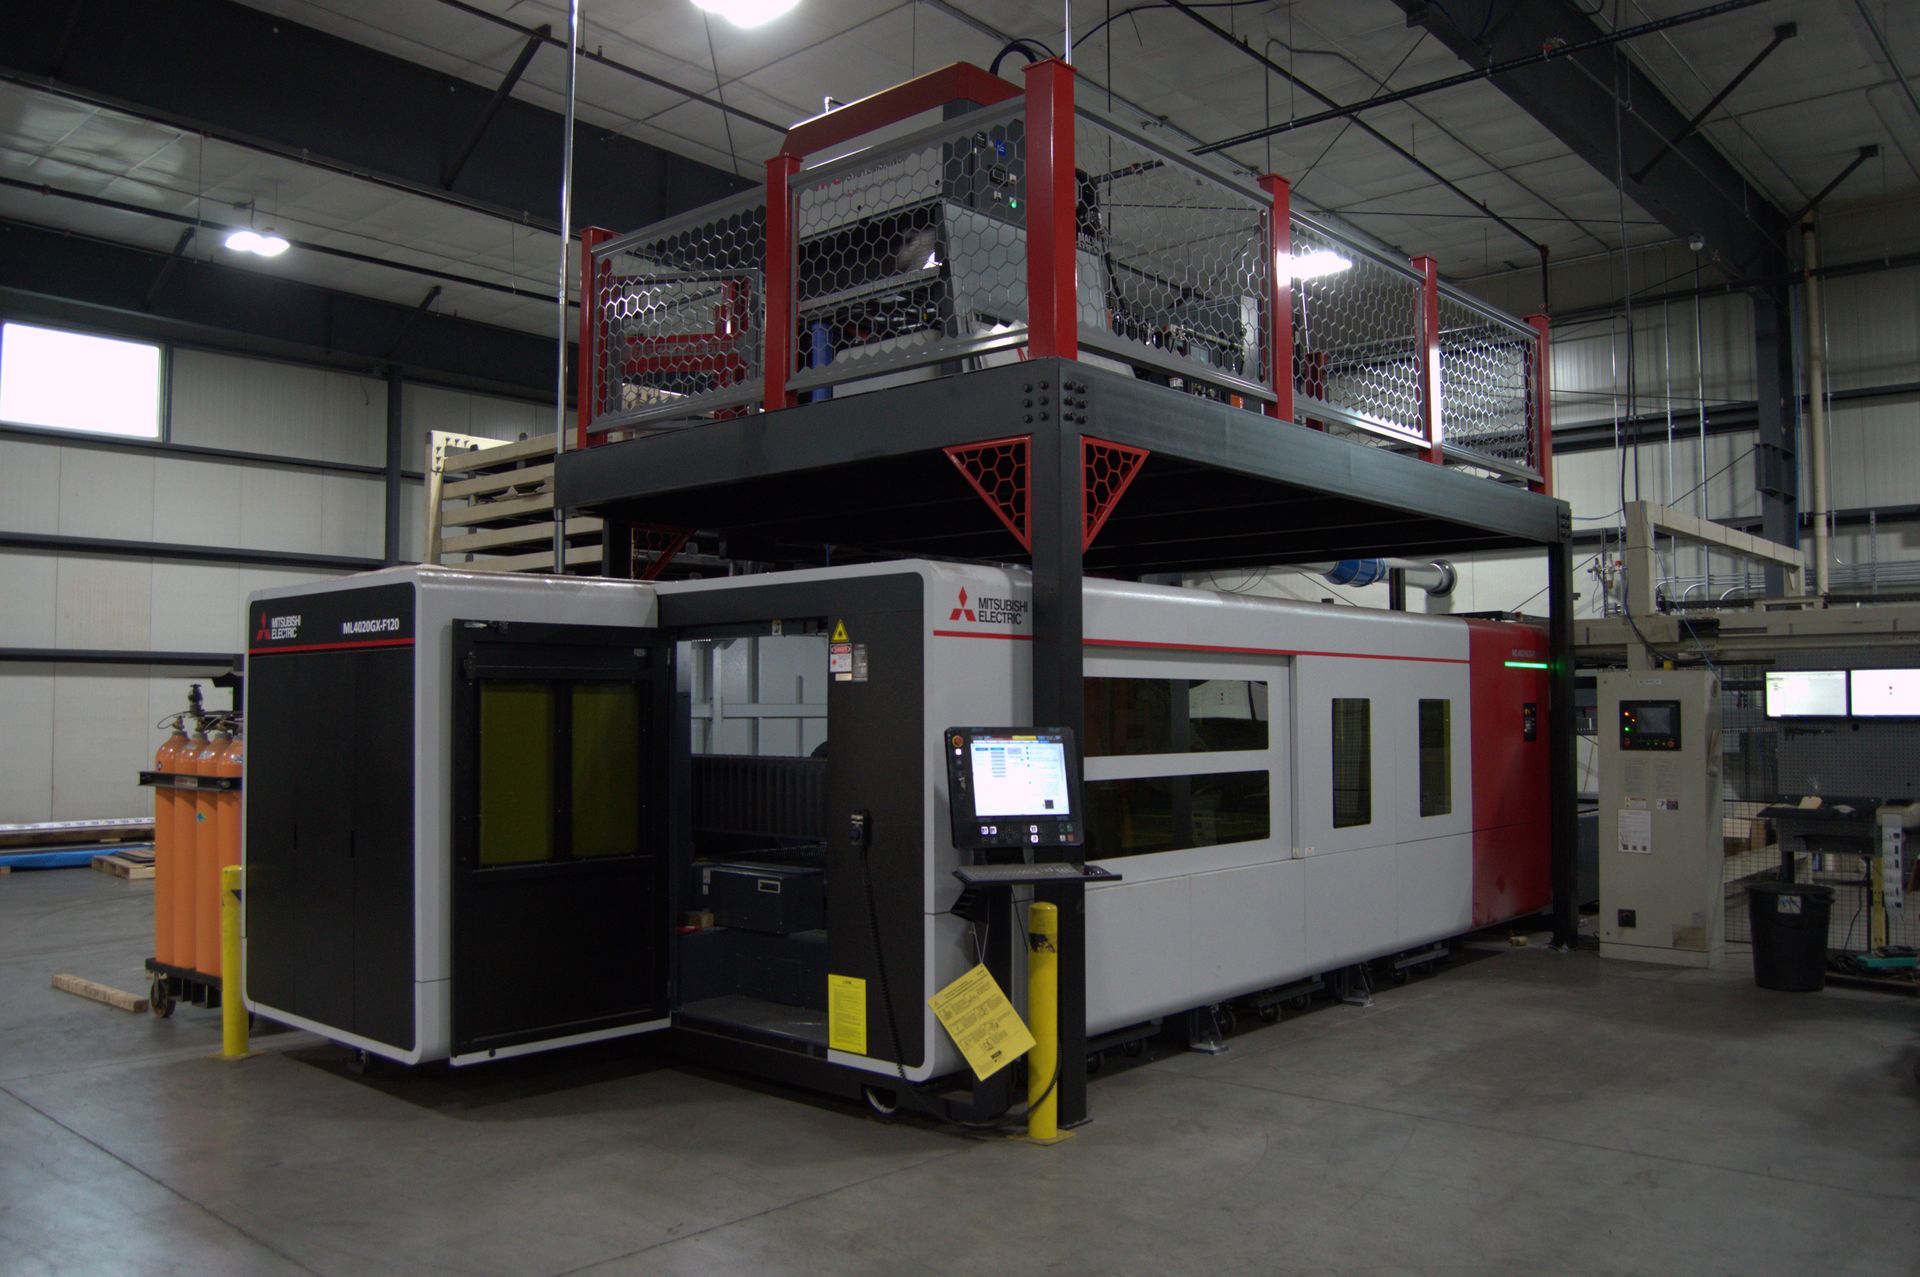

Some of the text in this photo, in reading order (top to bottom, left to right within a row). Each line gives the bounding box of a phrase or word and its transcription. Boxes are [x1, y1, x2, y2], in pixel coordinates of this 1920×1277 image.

[978, 597, 1028, 612] MITSUBISHI
[271, 615, 301, 627] MITSUBISHI
[978, 610, 1022, 625] ELECTRIC
[271, 627, 297, 640] ELECTRIC
[342, 618, 400, 634] ML4020GX-F120
